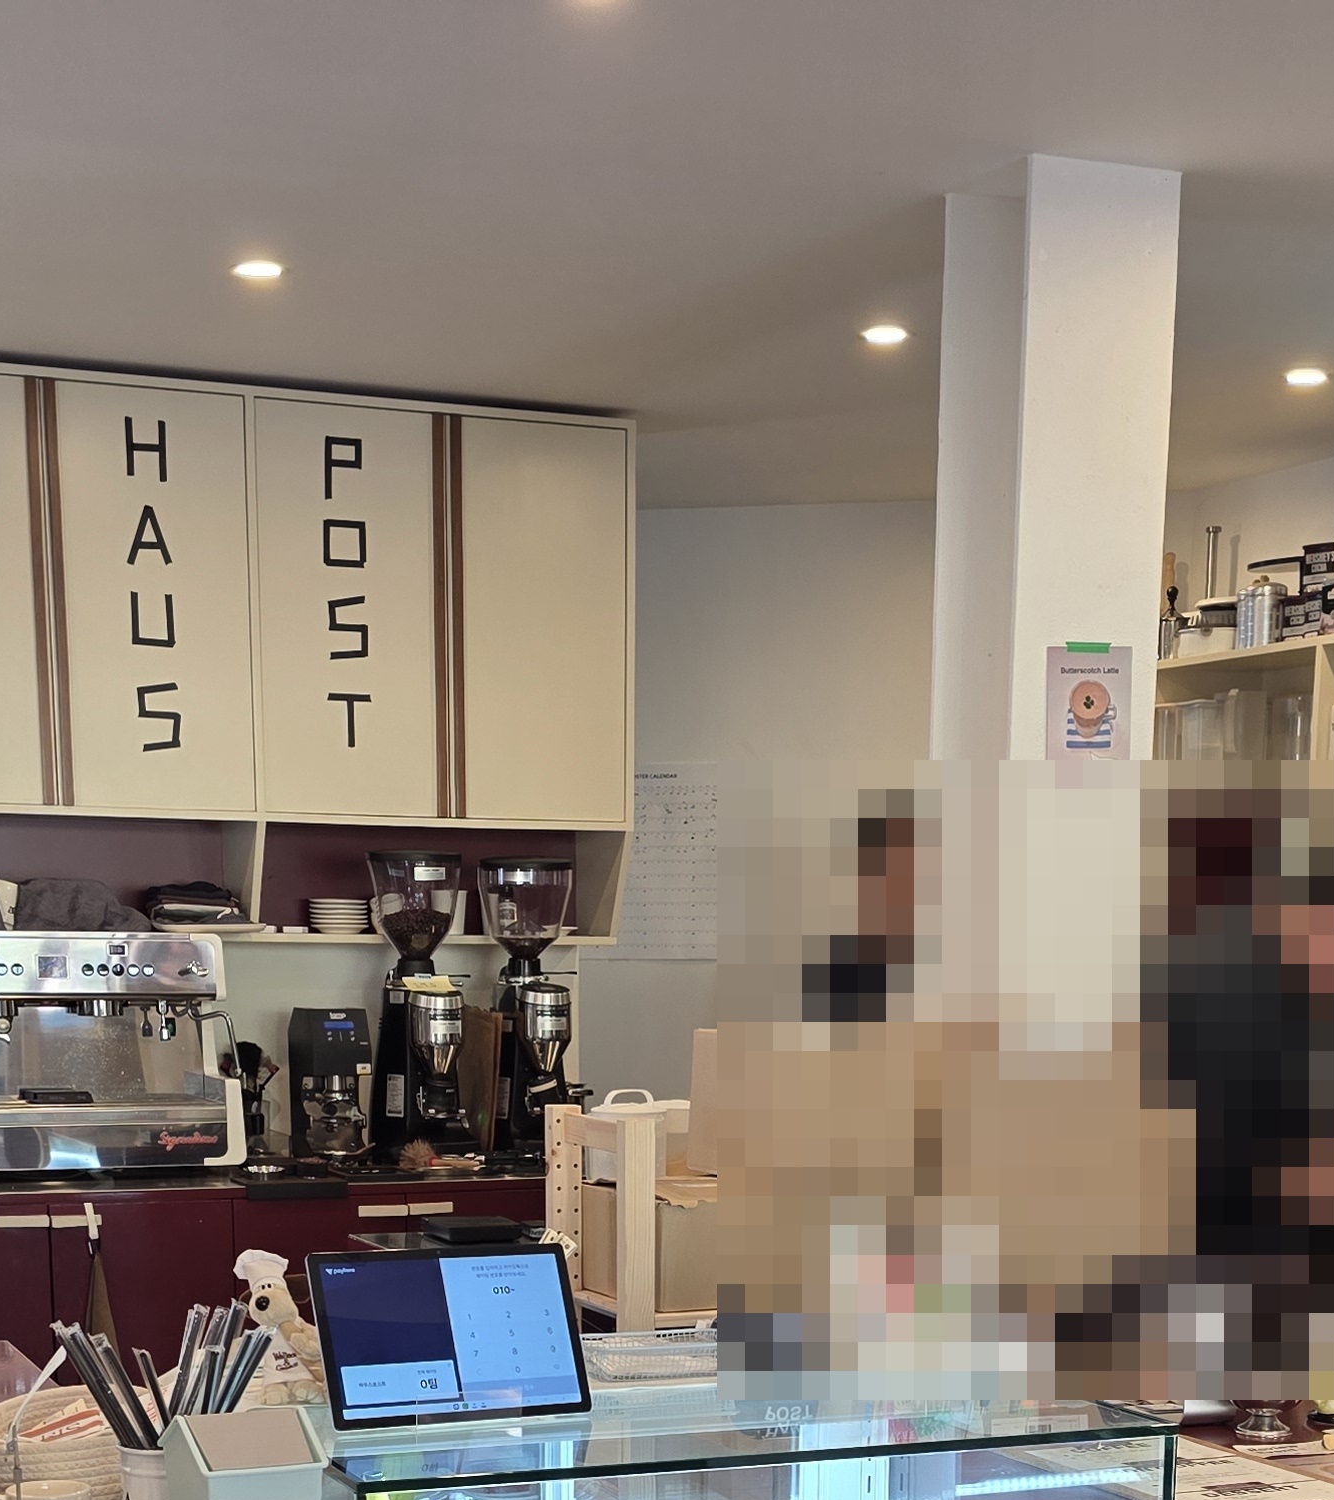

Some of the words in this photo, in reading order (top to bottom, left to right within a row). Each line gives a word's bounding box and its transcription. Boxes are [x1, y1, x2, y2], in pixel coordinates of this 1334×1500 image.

[124, 415, 181, 753] HAUS
[323, 435, 372, 748] POST
[1201, 1483, 1300, 1499] DESSERT
